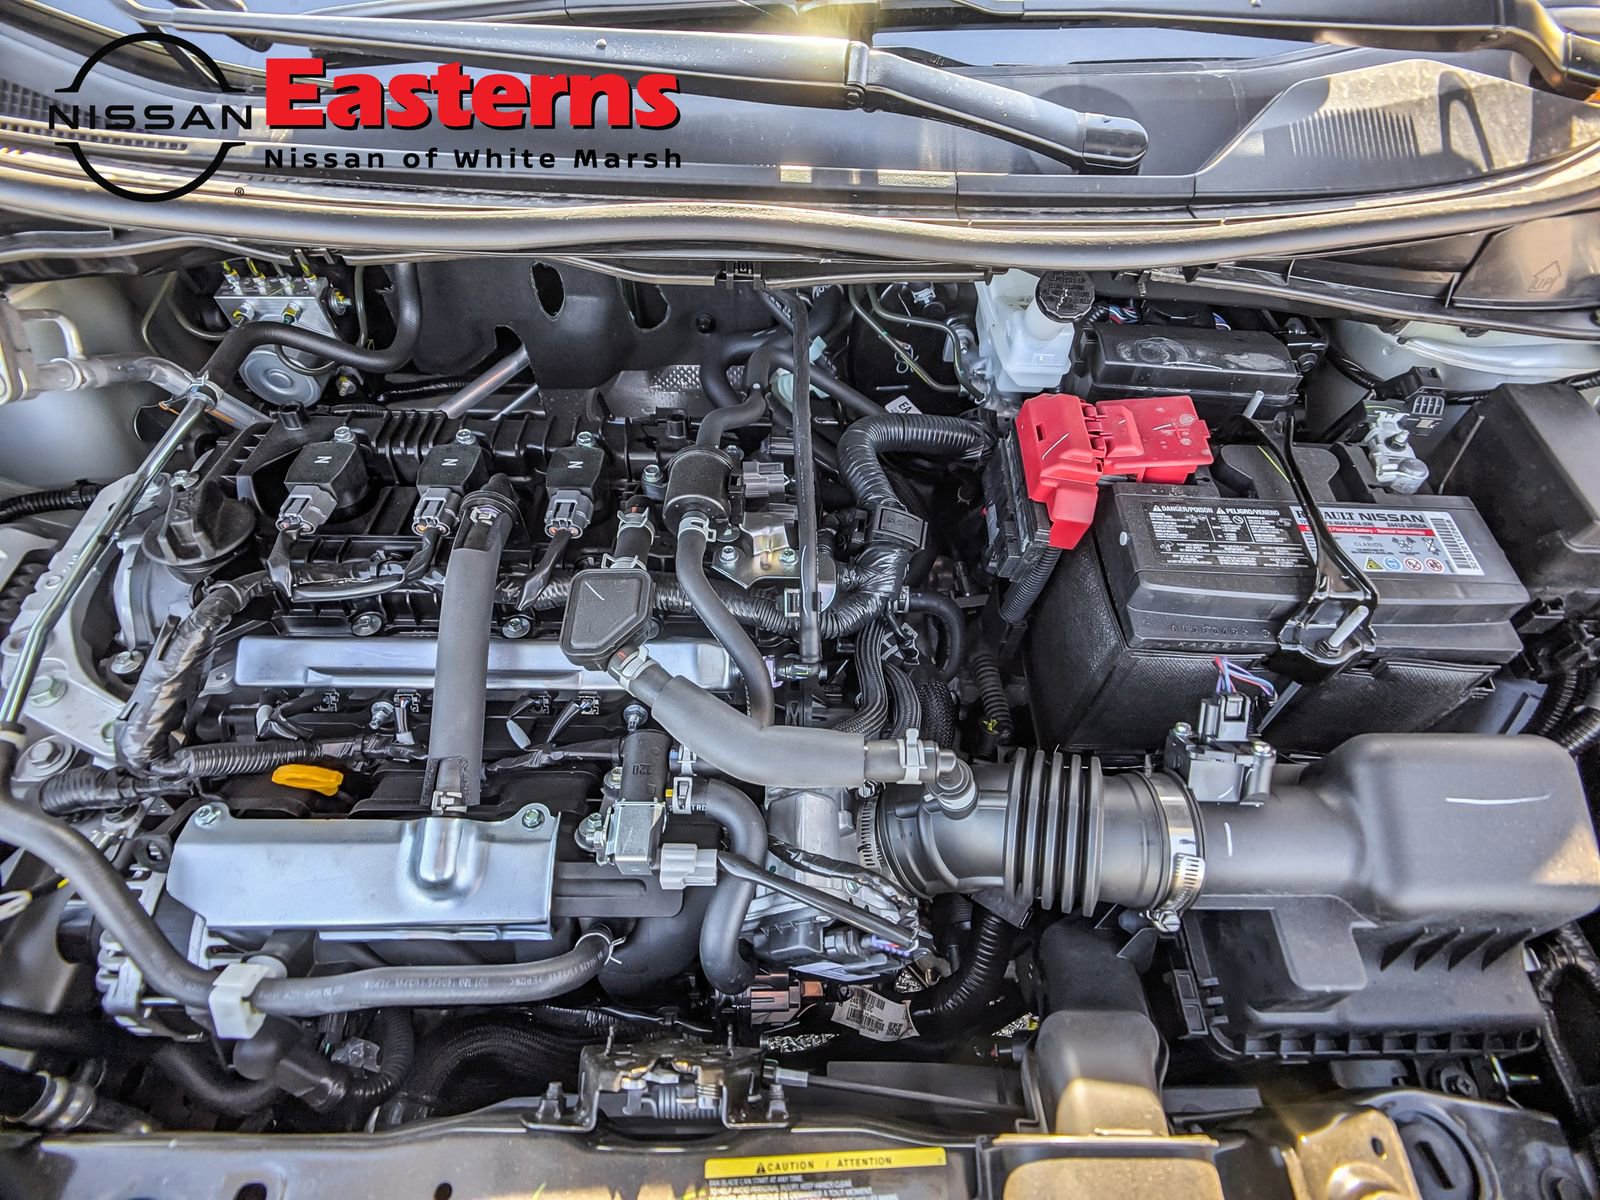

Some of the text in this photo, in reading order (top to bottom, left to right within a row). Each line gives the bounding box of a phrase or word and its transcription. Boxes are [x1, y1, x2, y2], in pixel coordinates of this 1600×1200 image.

[1358, 512, 1425, 523] NISSAN
[766, 1160, 815, 1173] CAUTION
[836, 1156, 893, 1168] ATTENTION
